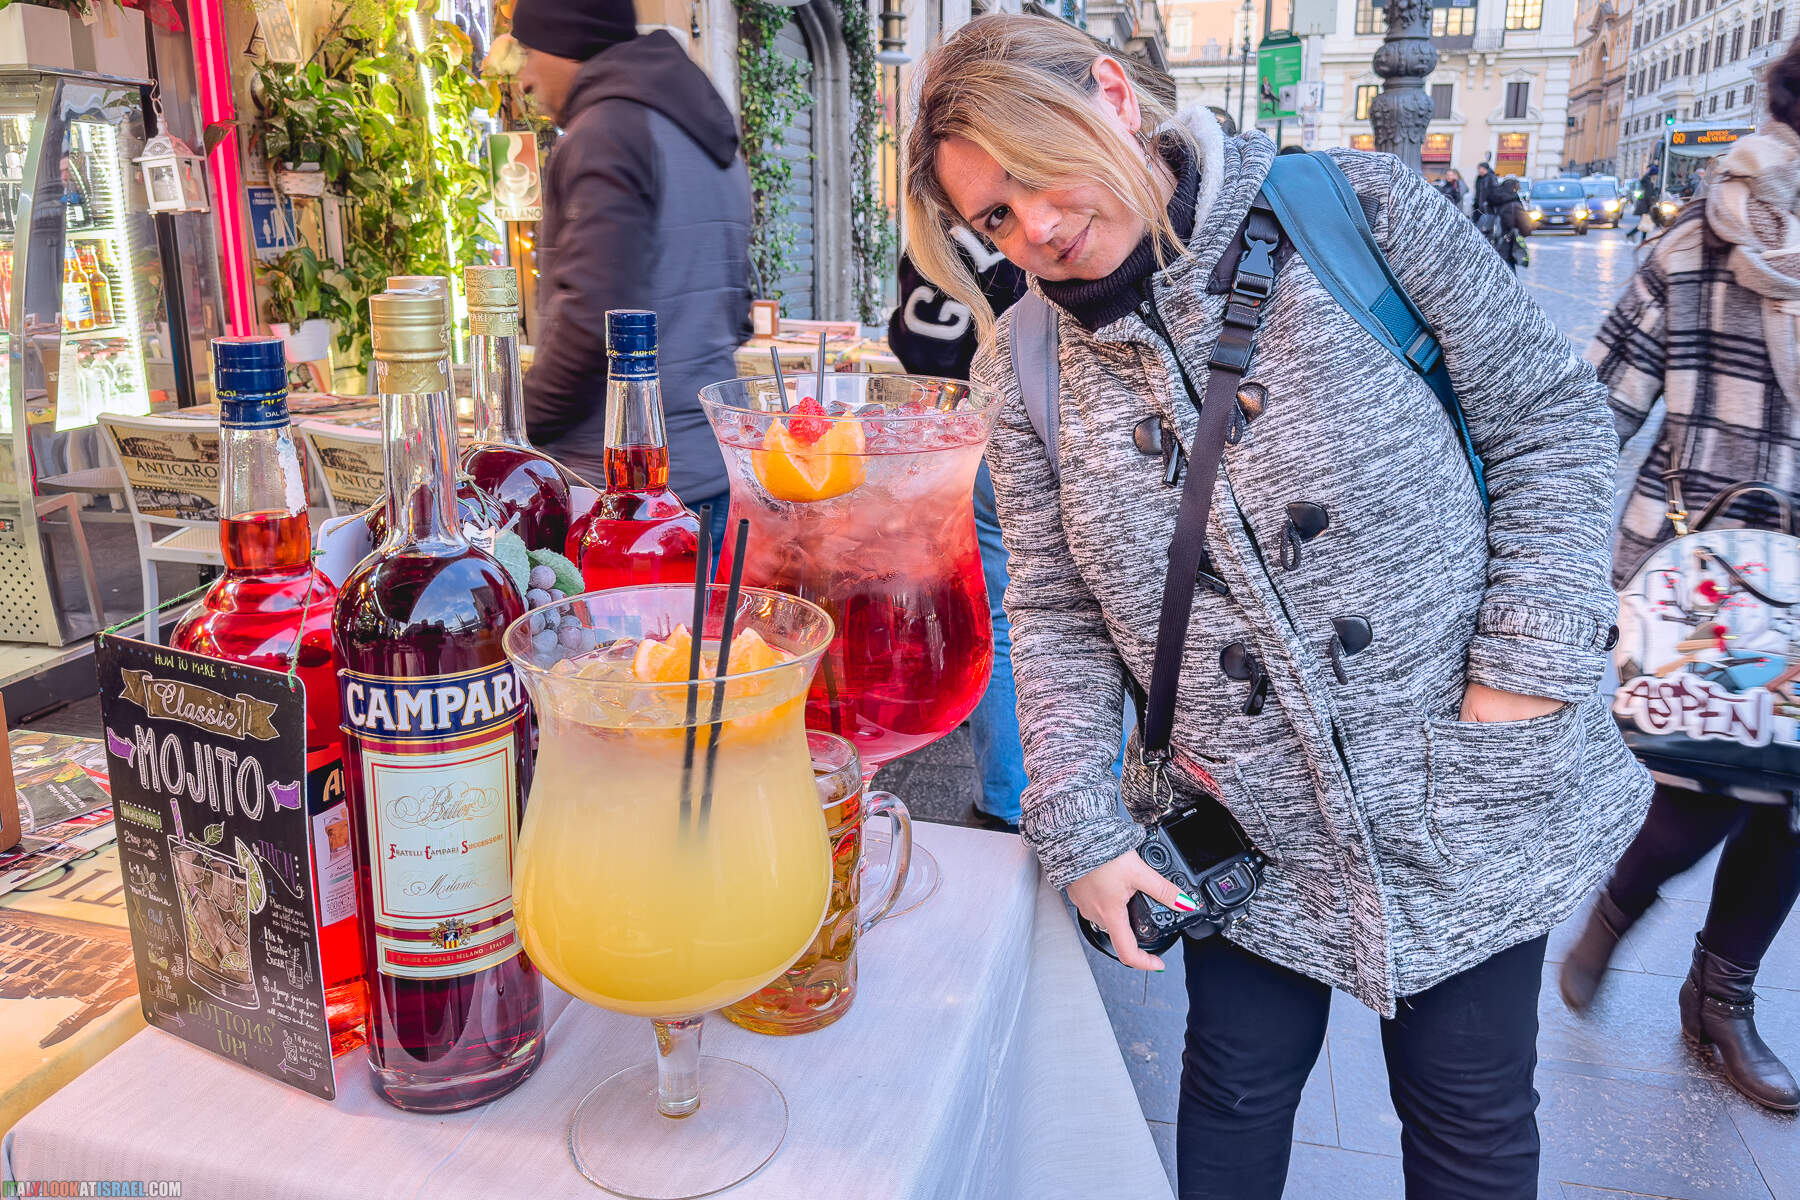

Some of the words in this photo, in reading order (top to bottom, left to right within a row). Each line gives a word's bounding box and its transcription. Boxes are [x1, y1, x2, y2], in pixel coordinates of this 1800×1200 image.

[136, 459, 218, 479] ANTICARO
[154, 654, 175, 668] HOW
[178, 657, 189, 671] TO
[192, 662, 217, 678] MAKE
[153, 683, 238, 730] Classic
[346, 671, 522, 732] CAMPARI
[135, 725, 265, 821] MOJITO
[387, 843, 423, 860] FRATELLI
[424, 846, 459, 860] CAMPARI
[456, 948, 484, 960] MILANO
[187, 993, 273, 1047] BOTTOMS
